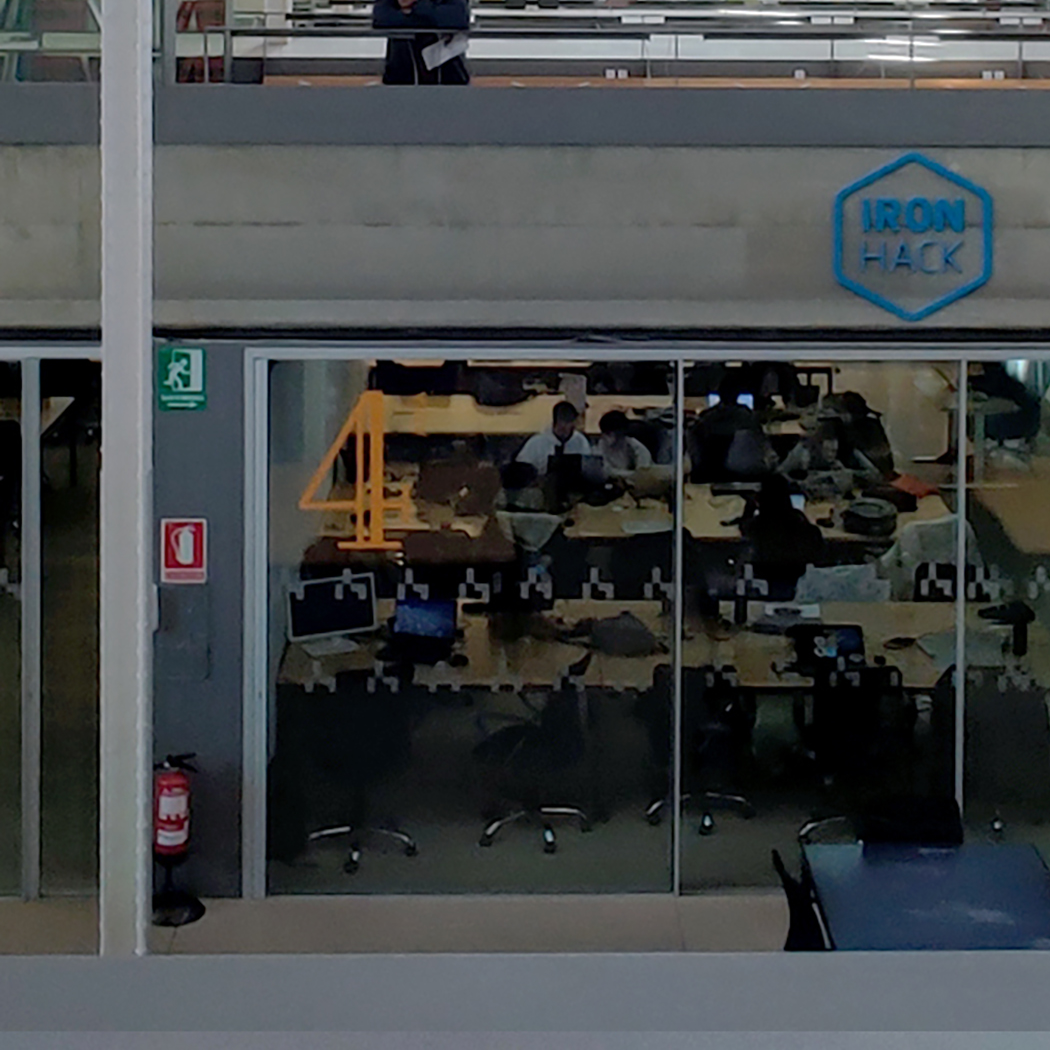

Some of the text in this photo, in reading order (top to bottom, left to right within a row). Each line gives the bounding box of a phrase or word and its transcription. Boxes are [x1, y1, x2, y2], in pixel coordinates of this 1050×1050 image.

[862, 197, 965, 233] IRON
[860, 239, 965, 274] HACK
[299, 390, 412, 550] 4
